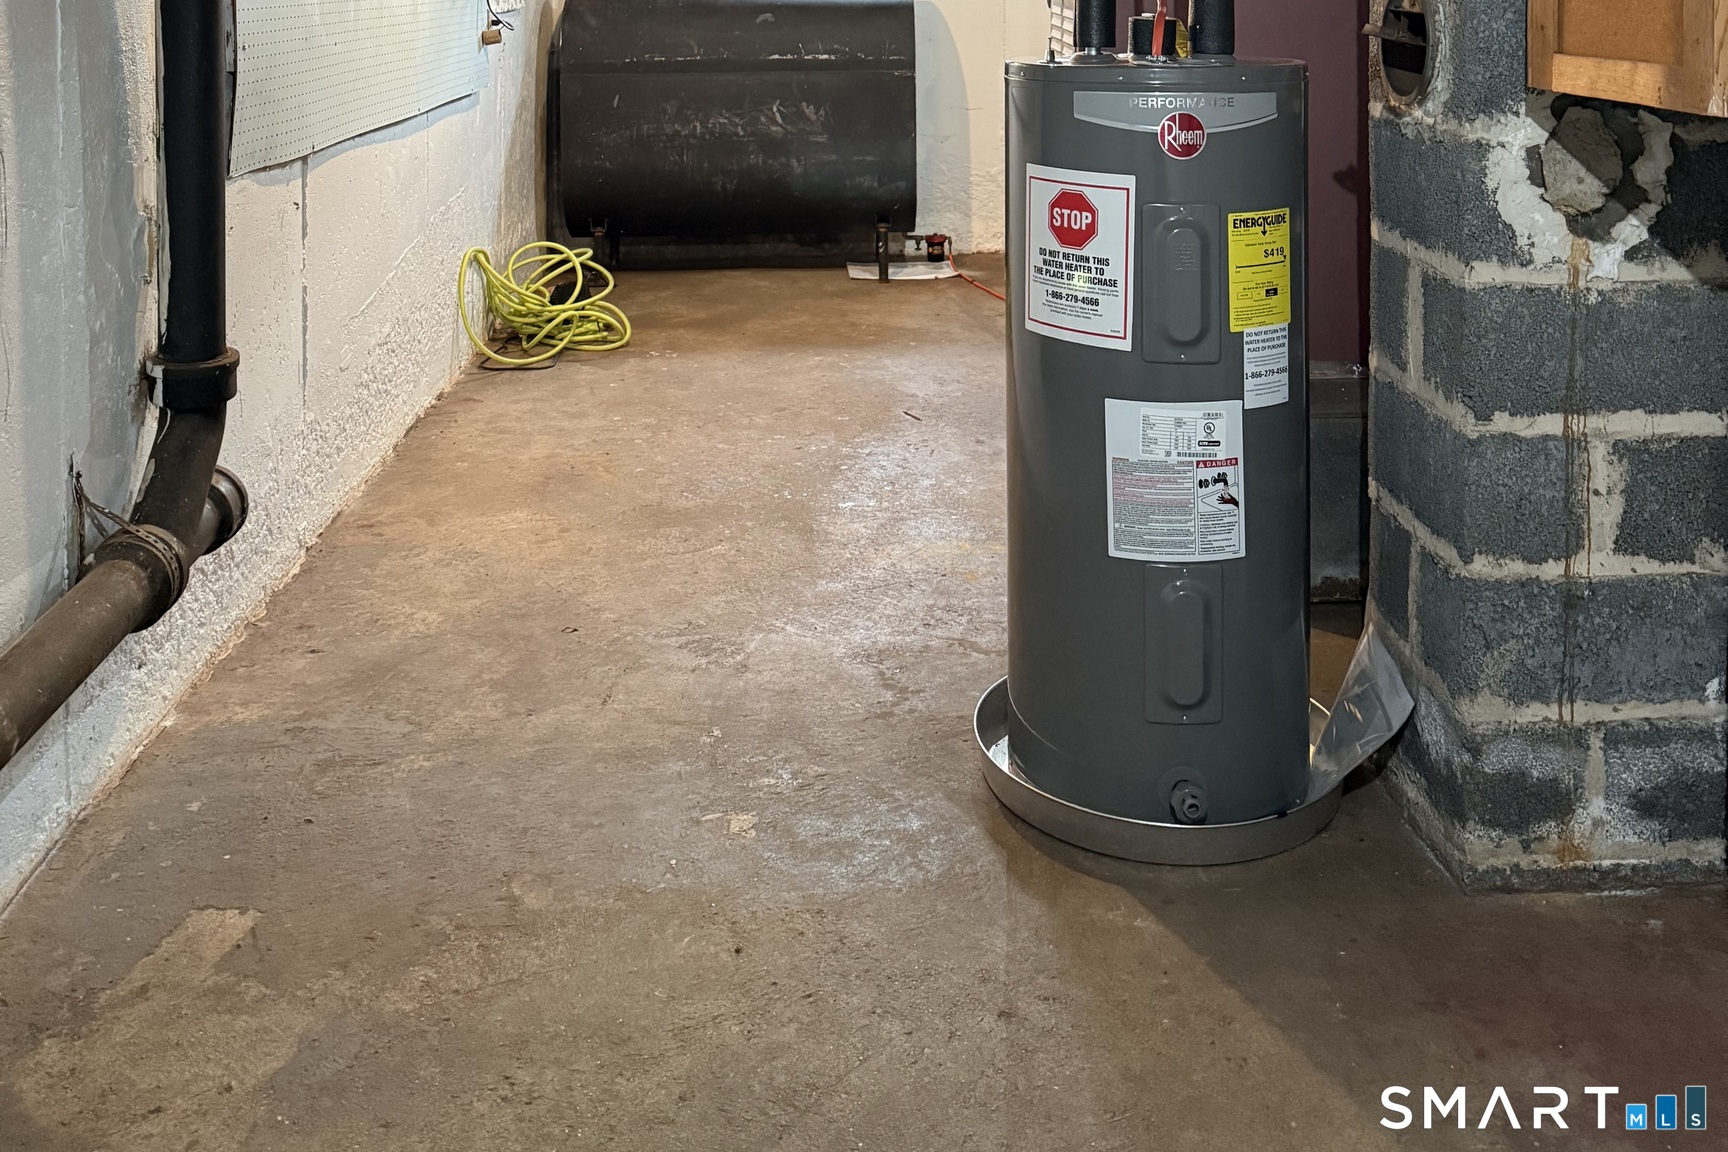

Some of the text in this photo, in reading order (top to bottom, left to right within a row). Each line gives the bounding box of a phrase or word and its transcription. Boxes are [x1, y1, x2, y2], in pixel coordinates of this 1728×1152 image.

[1129, 97, 1234, 108] PERFORMANCE
[1165, 113, 1202, 151] Rheem
[1052, 207, 1092, 231] STOP
[1039, 247, 1110, 267] DO NOT RETURN THIS
[1264, 247, 1284, 258] $419
[1042, 258, 1104, 276] WATER HEATER TO
[1033, 265, 1044, 275] THE
[1045, 268, 1065, 280] PLACE
[1066, 273, 1075, 282] OF
[1077, 275, 1118, 288] PURCHASE
[1045, 289, 1099, 307] 1-866-279-4566
[1261, 336, 1275, 344] HEATER
